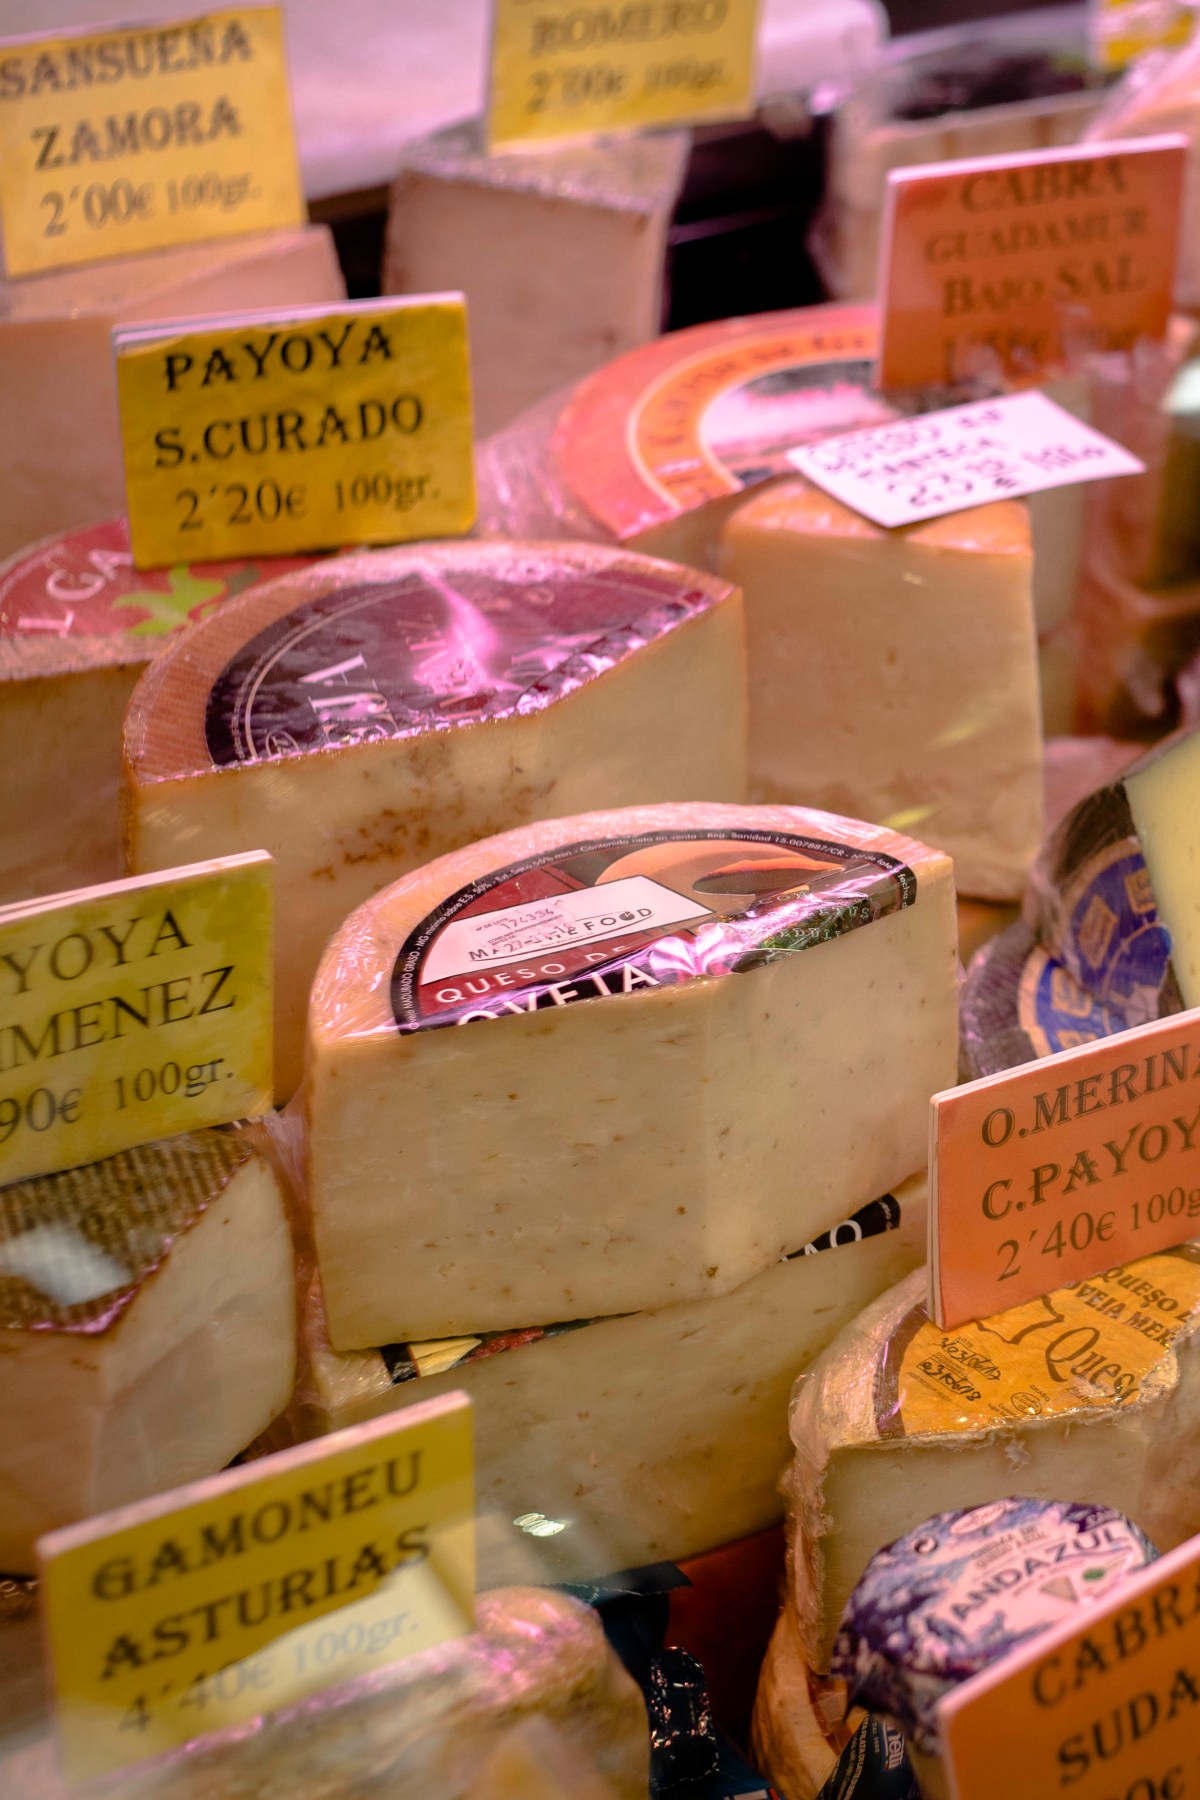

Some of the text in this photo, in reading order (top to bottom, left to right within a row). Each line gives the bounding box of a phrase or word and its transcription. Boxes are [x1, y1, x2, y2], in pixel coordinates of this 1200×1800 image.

[31, 95, 243, 171] ZAMORA
[166, 171, 262, 214] 100gr.
[959, 157, 1128, 213] CABRA
[1057, 250, 1151, 299] SAL
[162, 320, 396, 393] PAYOYA
[153, 395, 427, 470] S.CURADO
[178, 469, 441, 533] 2'20€ 100gr.
[580, 838, 630, 854] Contenido
[632, 834, 654, 844] neto
[656, 834, 669, 842] en
[670, 832, 698, 841] venta
[707, 832, 729, 841] Reg.
[731, 831, 772, 844] Sanidad
[2, 908, 192, 996] YOYA
[405, 950, 421, 973] GRASO
[416, 935, 431, 948] MG
[400, 972, 414, 1010] MADURADO
[436, 963, 565, 1004] QUESO
[114, 1056, 234, 1112] 100gr.
[996, 1209, 1116, 1282] 2'40€
[1099, 1266, 1181, 1313] QUESO
[91, 1450, 424, 1603] GAMONEU
[100, 1524, 433, 1682] ASTURIAS
[293, 1605, 420, 1677] 100gr.
